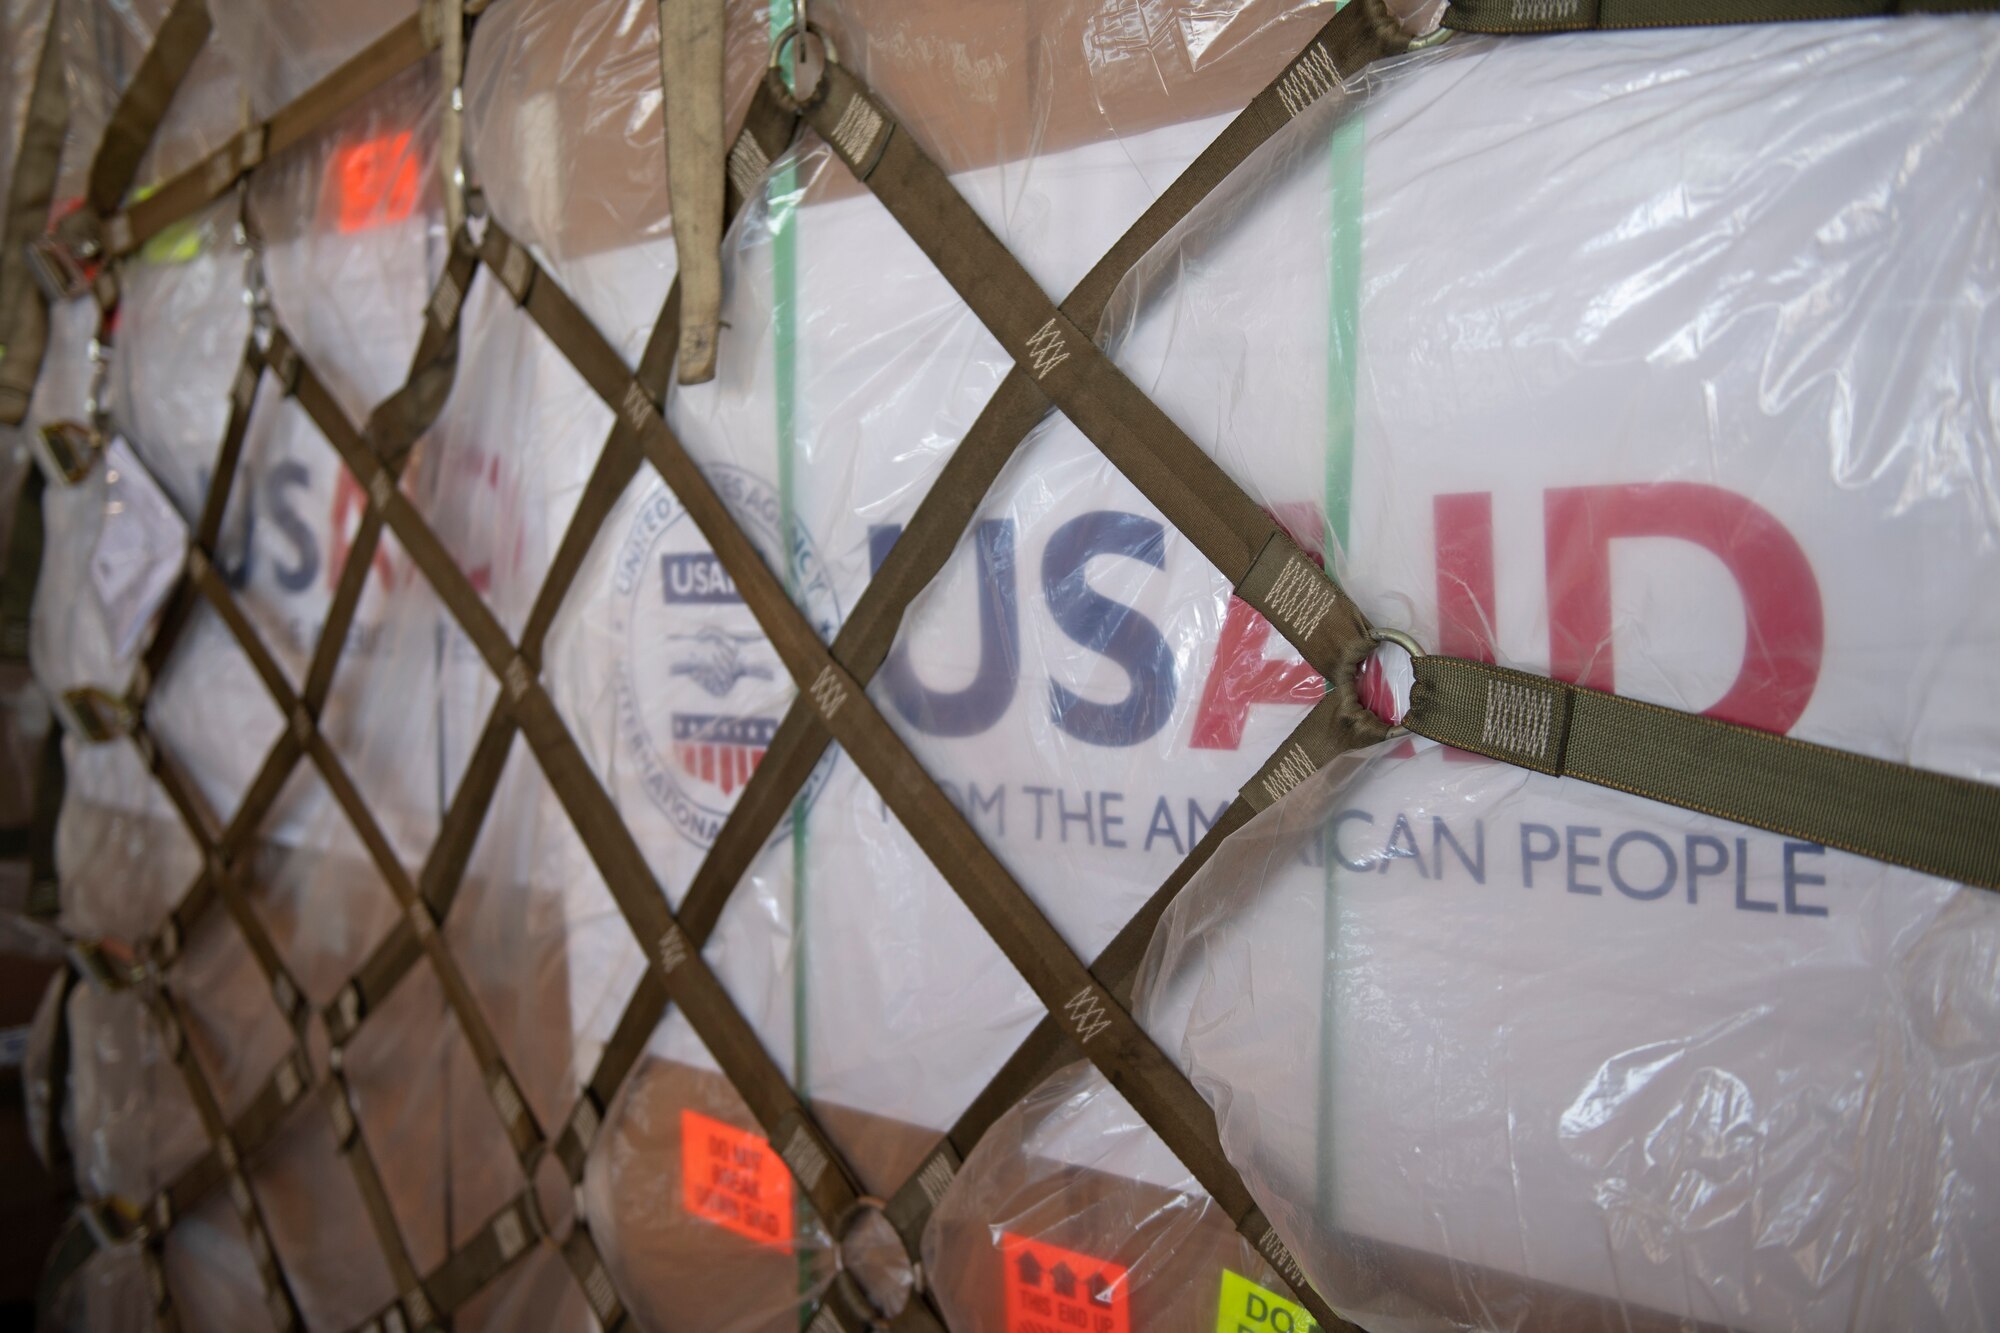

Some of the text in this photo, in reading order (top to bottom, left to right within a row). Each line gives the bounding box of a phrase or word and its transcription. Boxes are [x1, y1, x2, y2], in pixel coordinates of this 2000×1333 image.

[1022, 785, 1128, 849] THE
[1520, 822, 1829, 917] PEOPLE
[1058, 1302, 1089, 1329] END
[1093, 1312, 1115, 1333] UP
[1246, 1291, 1294, 1333] DO
